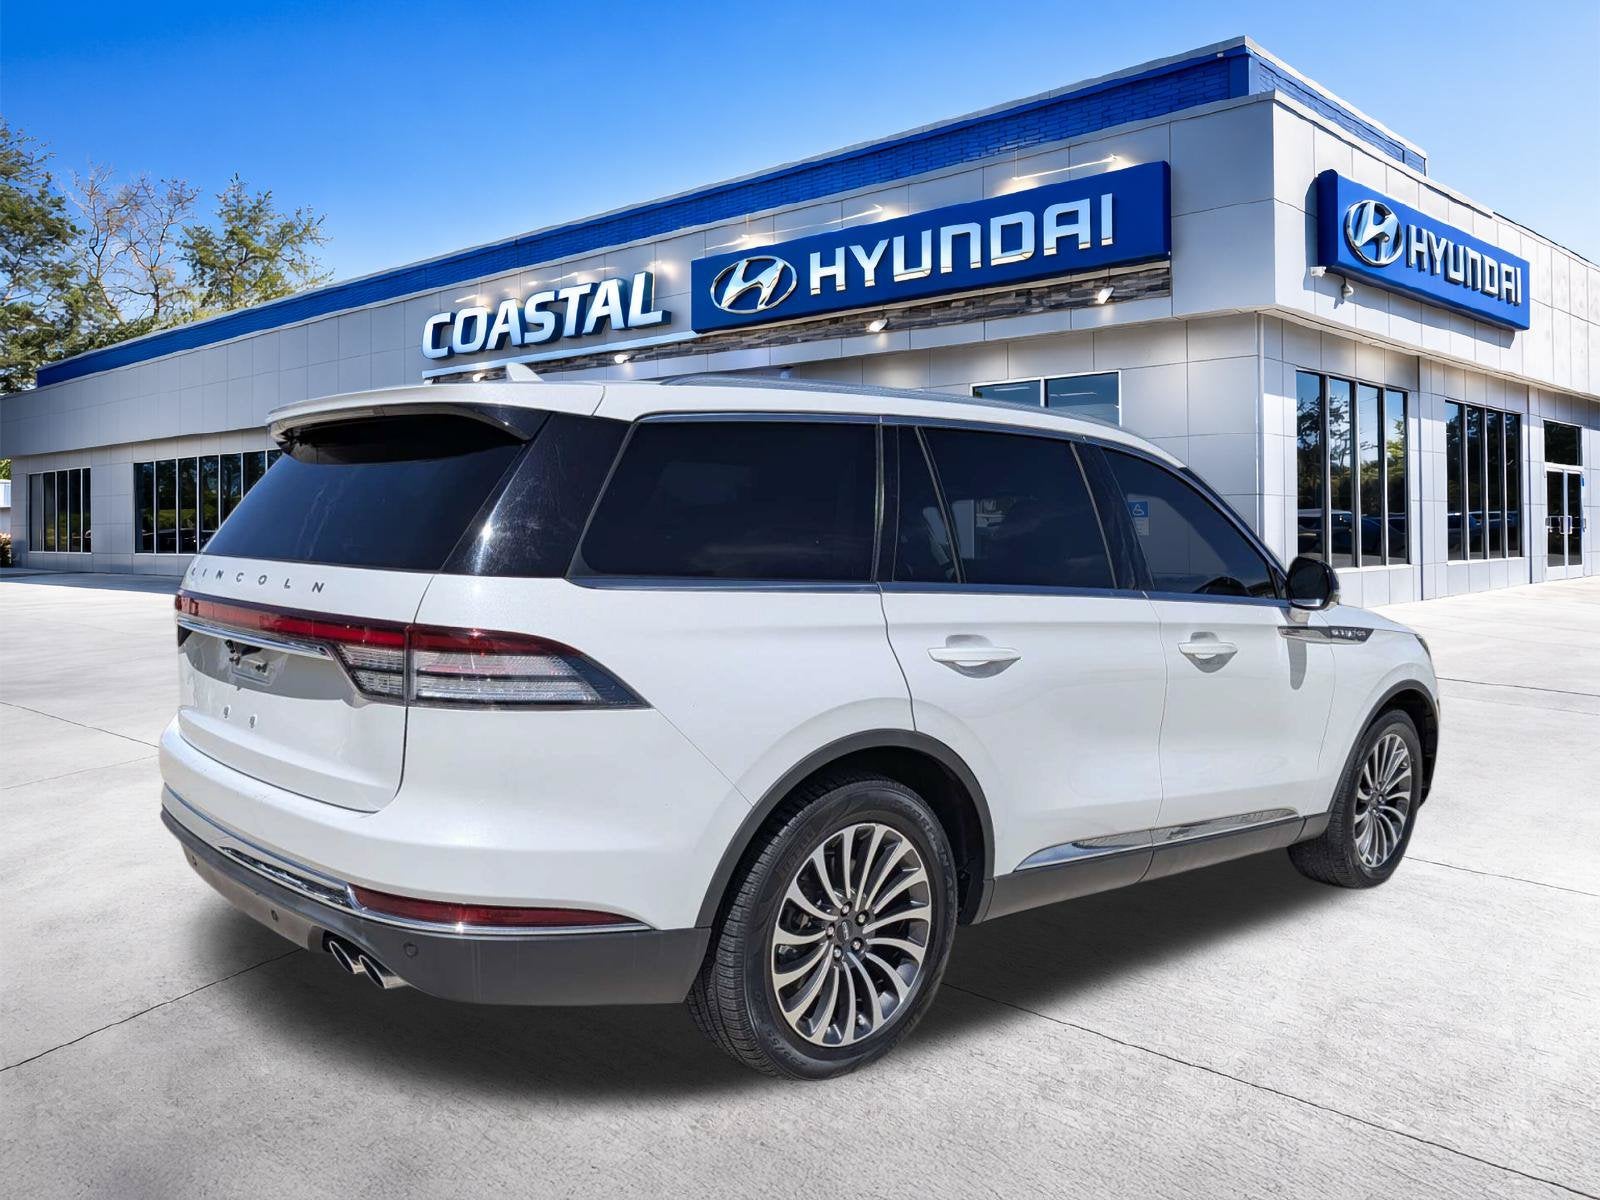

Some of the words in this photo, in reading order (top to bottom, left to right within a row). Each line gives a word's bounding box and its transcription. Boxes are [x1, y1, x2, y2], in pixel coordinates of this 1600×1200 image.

[810, 192, 1113, 295] HYUNDAI
[1406, 224, 1522, 306] HYUNDAI
[422, 271, 669, 359] COASTAL
[191, 567, 326, 593] LINCOLN
